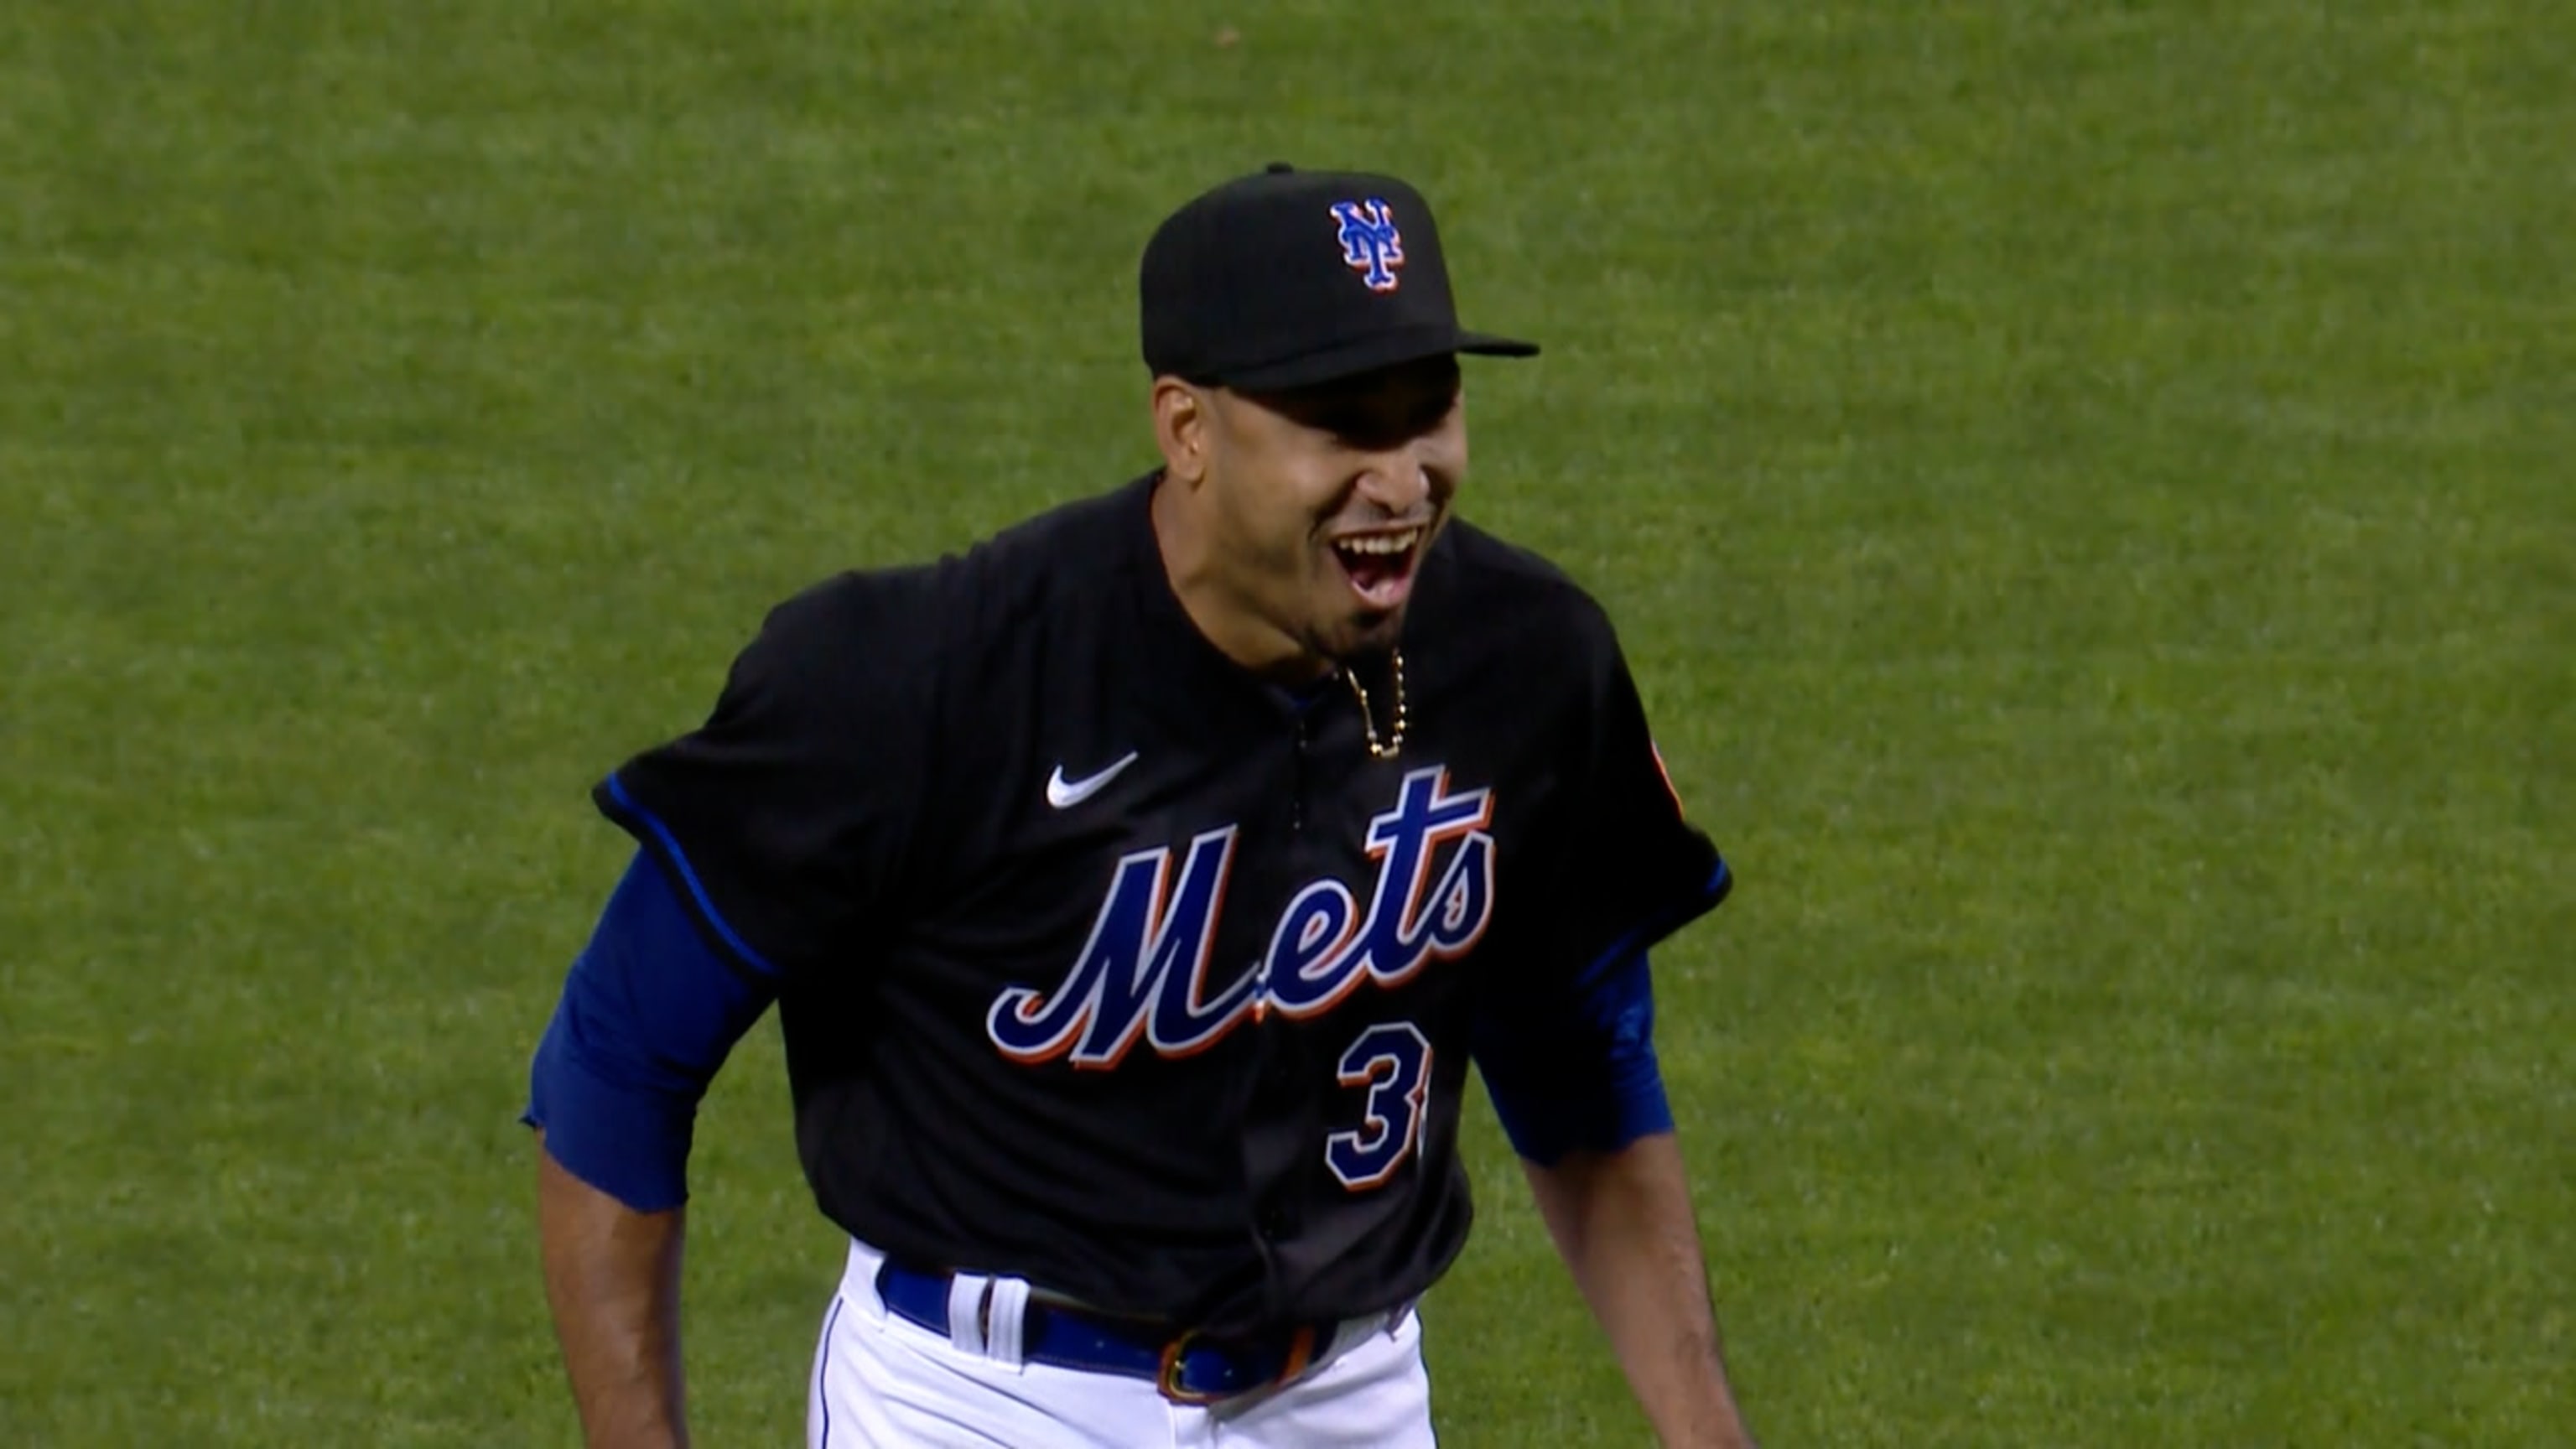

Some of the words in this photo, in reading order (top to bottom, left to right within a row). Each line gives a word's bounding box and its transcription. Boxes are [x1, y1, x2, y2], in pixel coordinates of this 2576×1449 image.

[1330, 197, 1405, 293] NY
[987, 765, 1496, 1071] Mets
[1325, 1021, 1433, 1191] 3
